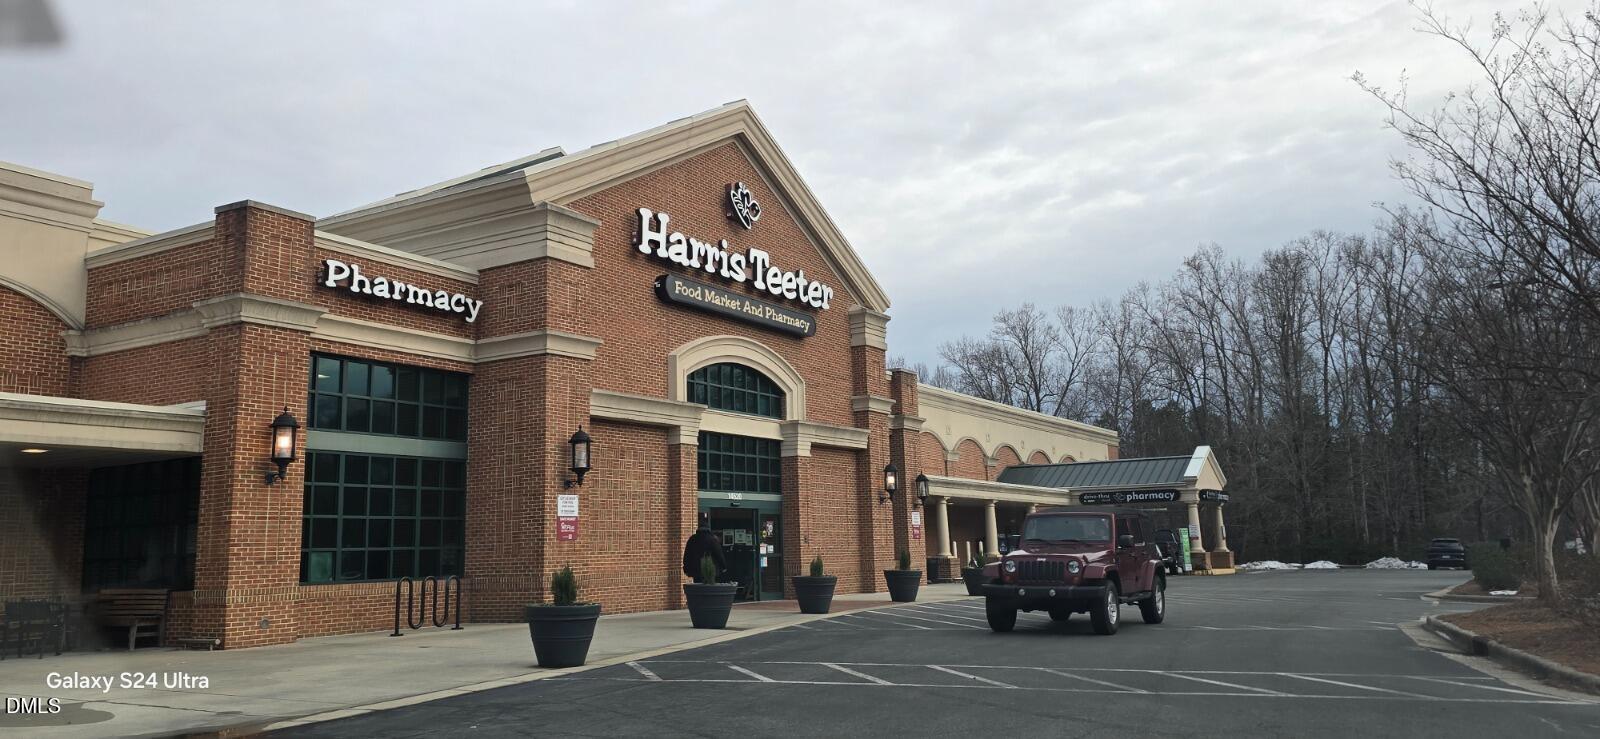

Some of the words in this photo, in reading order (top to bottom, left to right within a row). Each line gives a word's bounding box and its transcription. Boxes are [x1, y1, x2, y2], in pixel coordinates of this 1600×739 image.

[637, 207, 747, 283] Harris
[749, 247, 834, 310] Teeter
[324, 259, 484, 323] Pharmacy
[674, 280, 702, 301] Food
[704, 289, 742, 311] Market
[742, 301, 764, 318] And
[764, 306, 811, 333] Pharmacy
[1126, 491, 1175, 502] pharmacy
